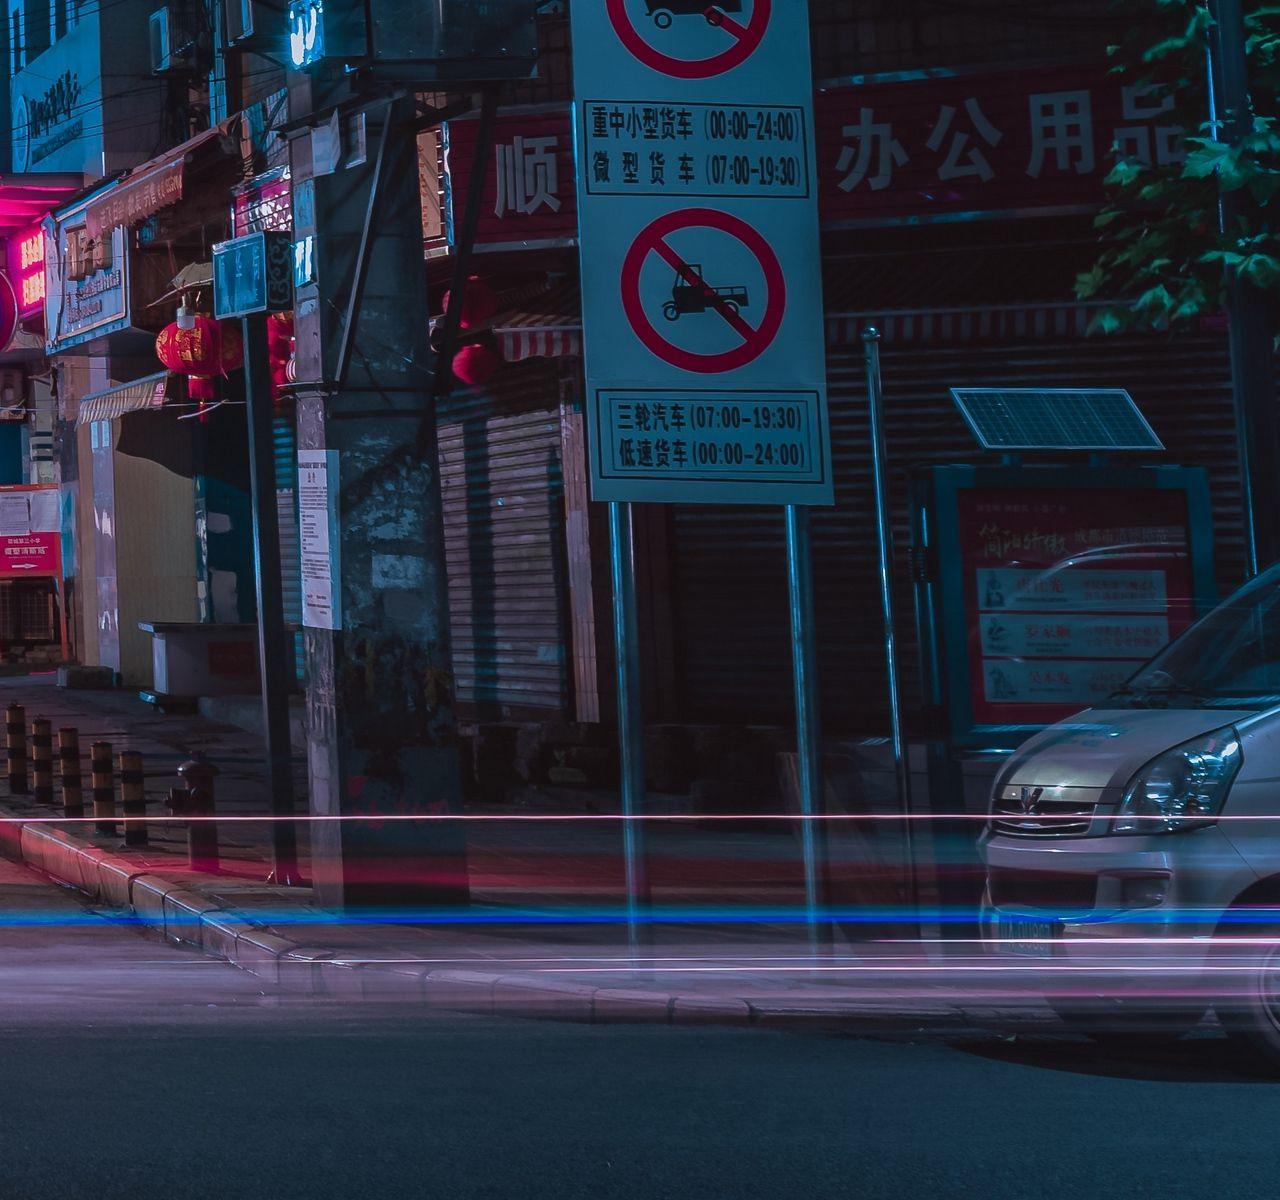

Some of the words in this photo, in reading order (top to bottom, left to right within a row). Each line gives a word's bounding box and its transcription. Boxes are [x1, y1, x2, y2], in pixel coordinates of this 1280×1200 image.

[592, 106, 693, 140] 重中小型货车
[494, 135, 562, 219] 顺
[835, 83, 1186, 193] 办公用品
[618, 403, 686, 432] 三轮汽车
[620, 438, 688, 468] 低速货车
